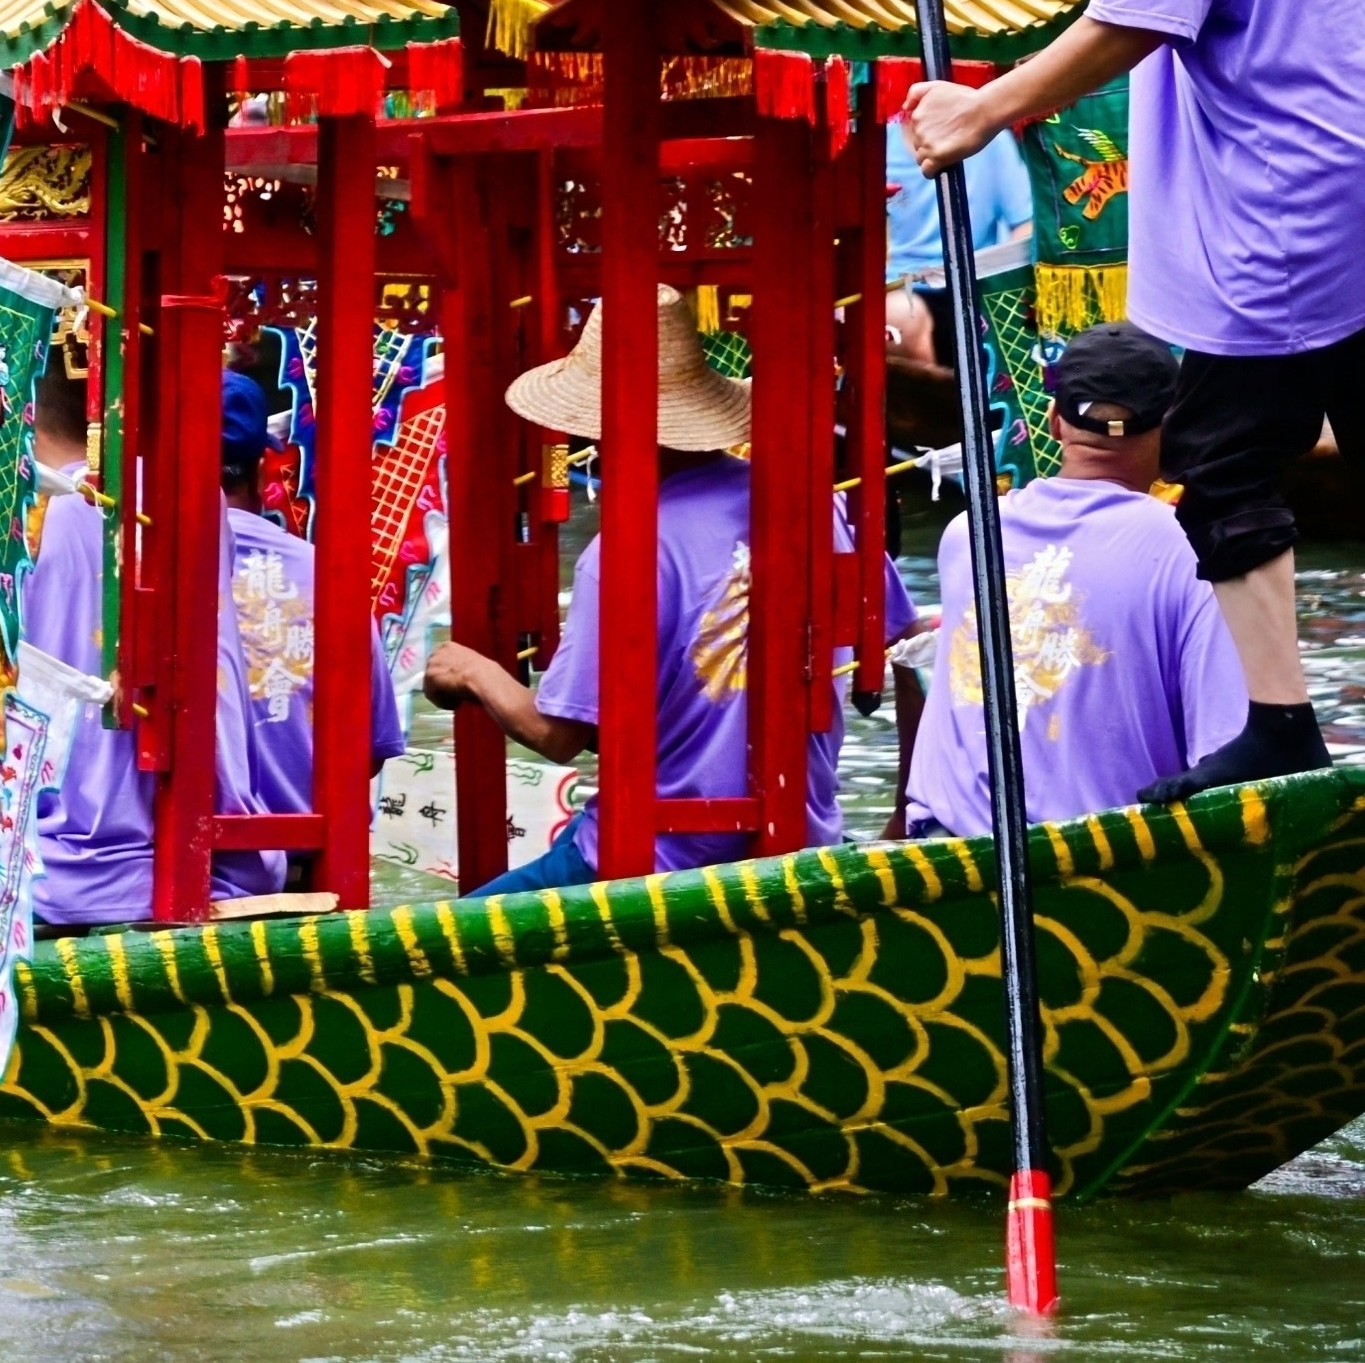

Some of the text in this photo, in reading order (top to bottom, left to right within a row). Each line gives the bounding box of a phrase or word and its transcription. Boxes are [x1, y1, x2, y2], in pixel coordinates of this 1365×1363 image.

[238, 548, 315, 727] 龍舟勝會
[378, 792, 527, 847] 龍舟會
